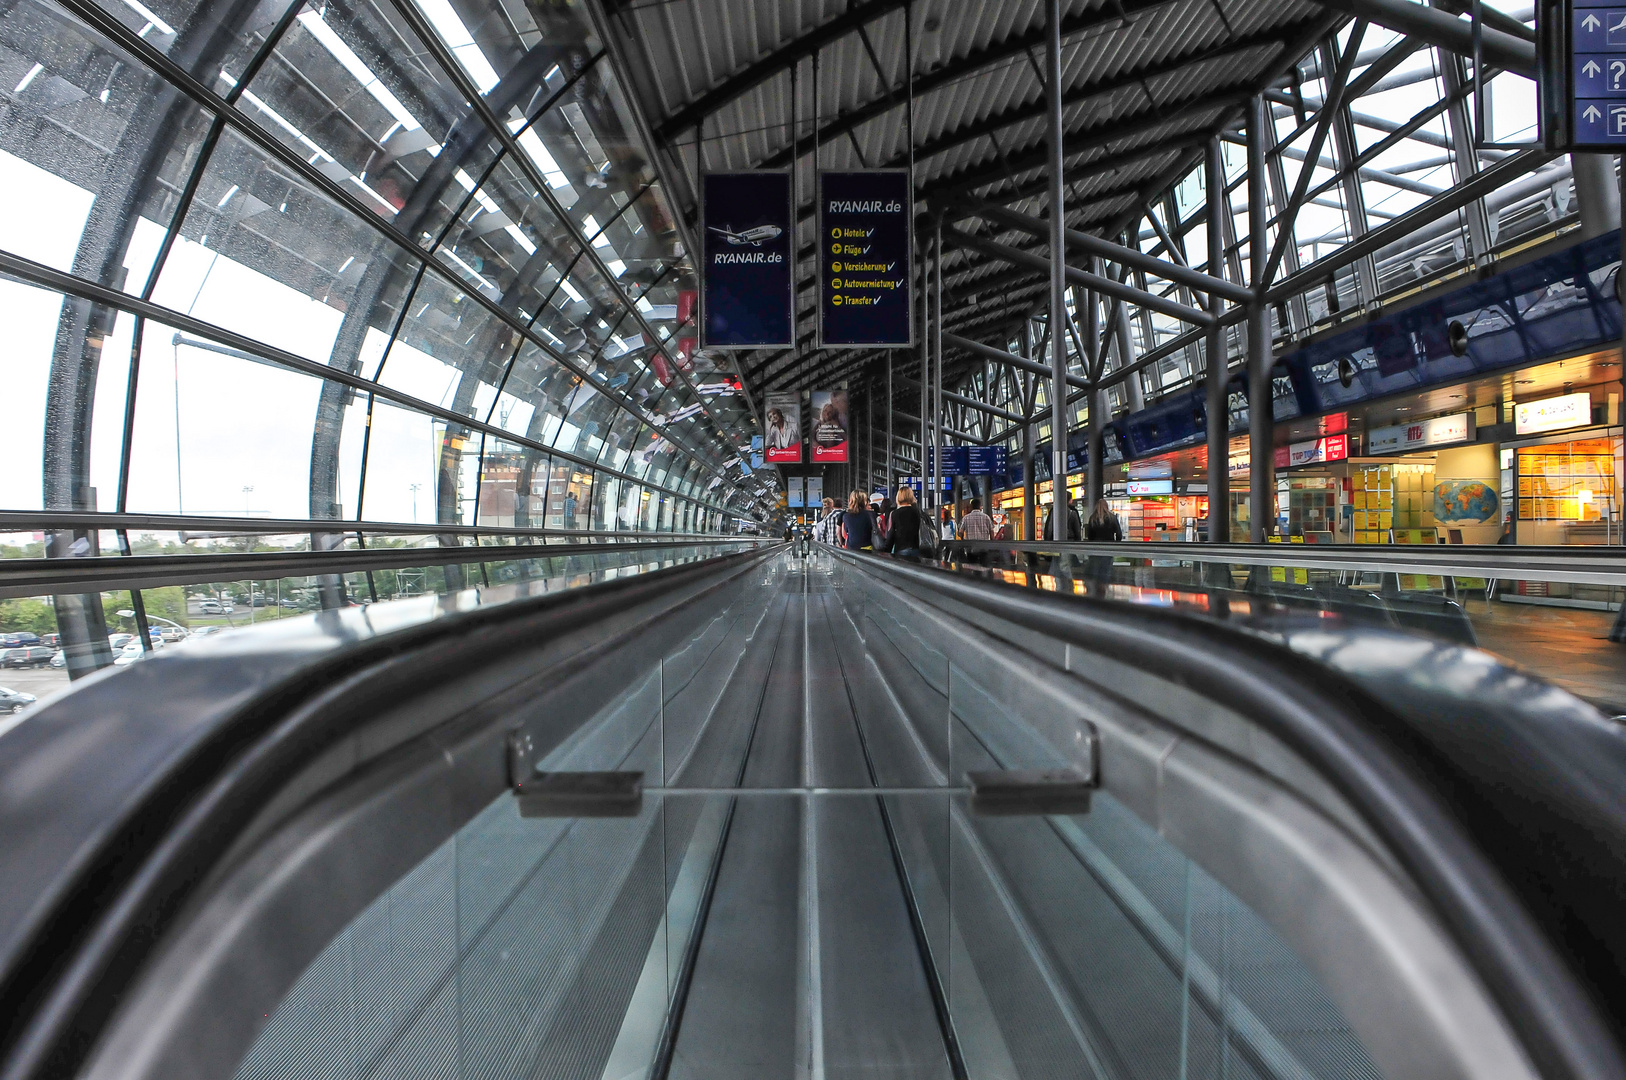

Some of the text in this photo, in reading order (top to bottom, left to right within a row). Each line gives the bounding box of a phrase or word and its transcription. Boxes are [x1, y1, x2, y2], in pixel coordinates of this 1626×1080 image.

[829, 200, 902, 213] RYANAIR.de
[844, 228, 865, 237] Hotels
[844, 245, 862, 256] Flüge
[714, 252, 782, 264] RYANAIR.de
[844, 262, 886, 273] Versicherung
[844, 278, 895, 290] Autovermietung
[845, 296, 873, 305] Transfer
[1292, 451, 1303, 460] TOP
